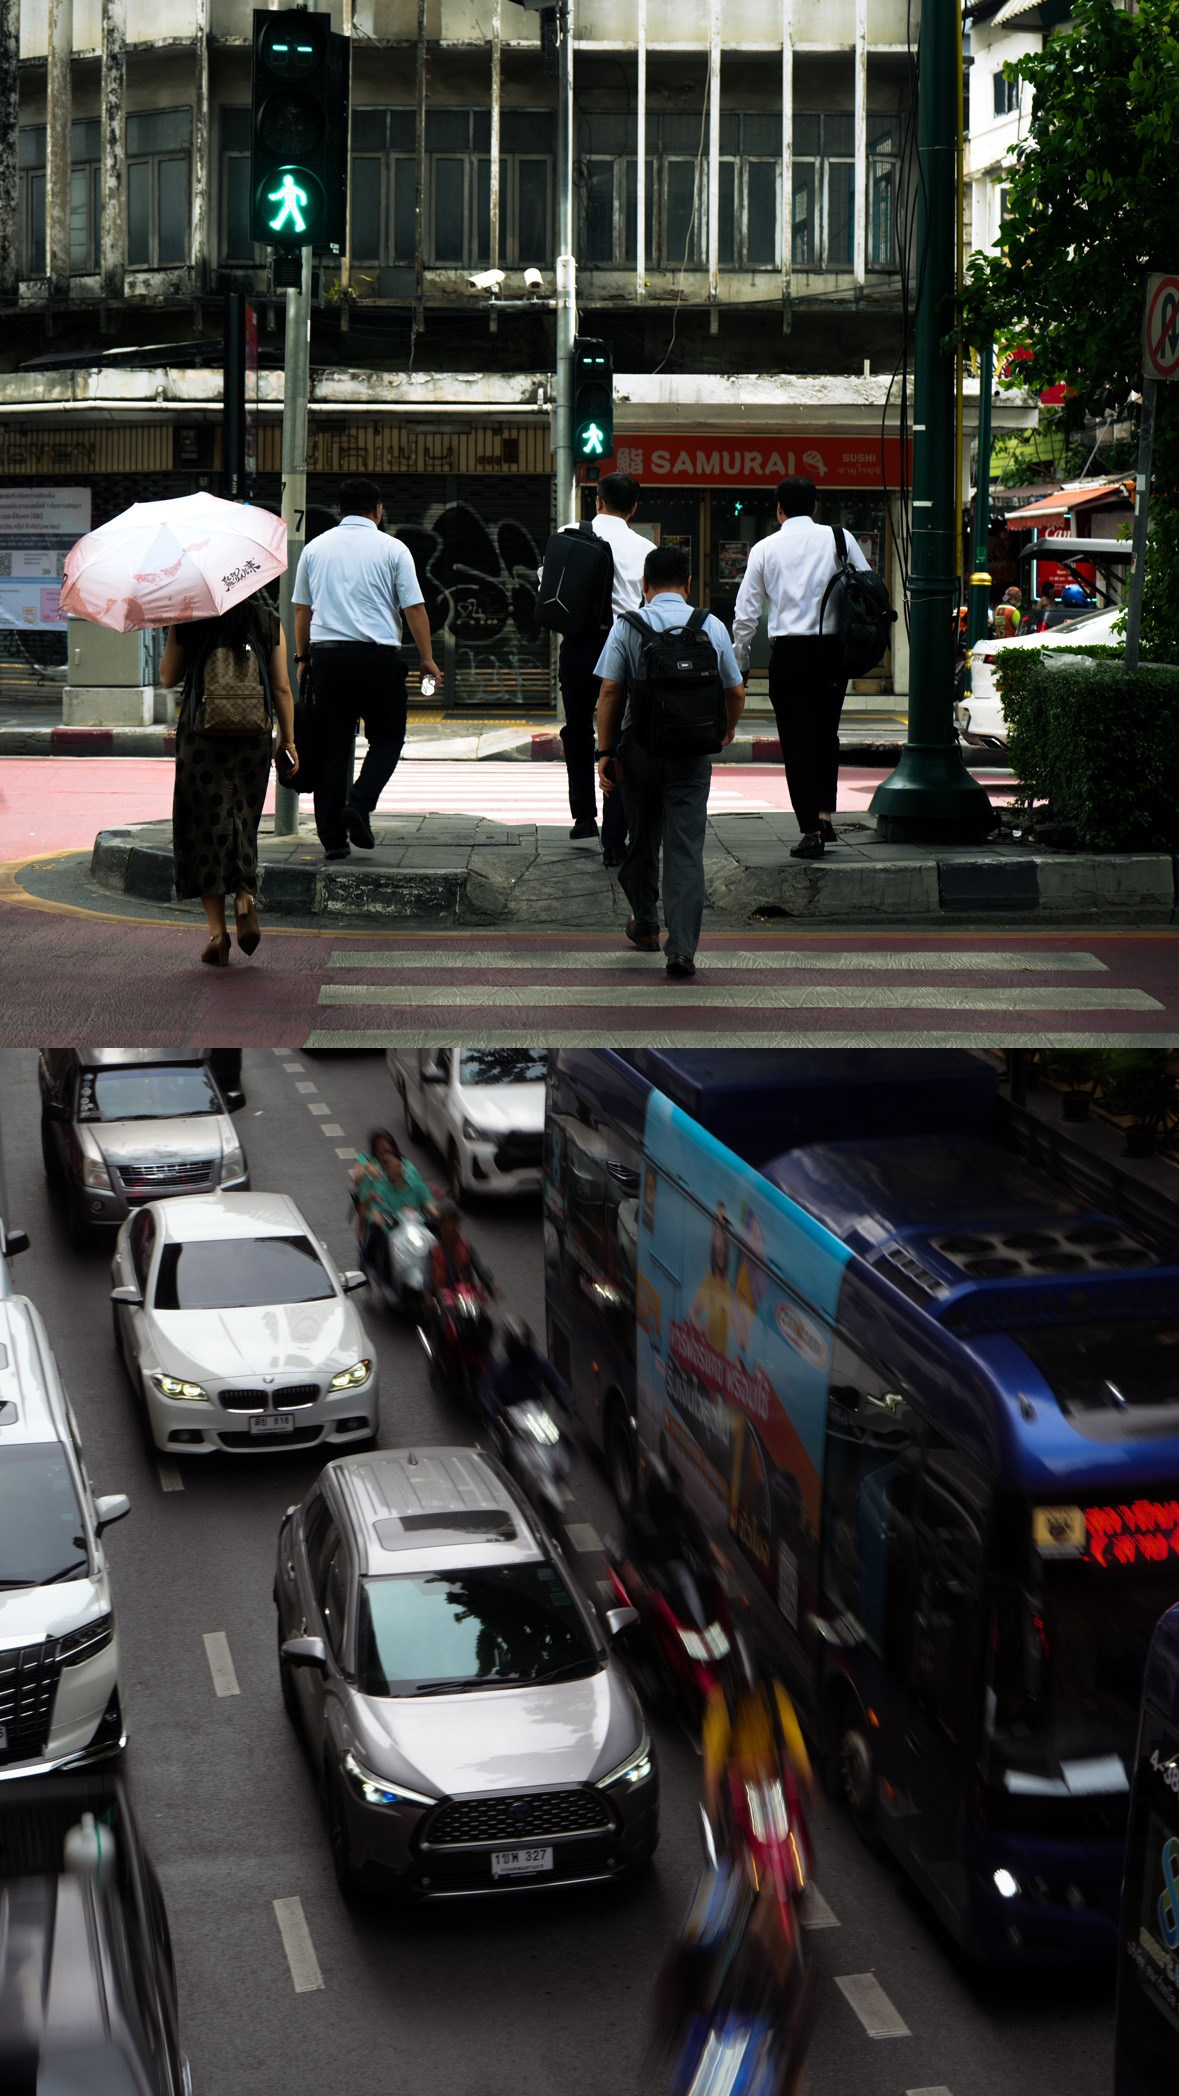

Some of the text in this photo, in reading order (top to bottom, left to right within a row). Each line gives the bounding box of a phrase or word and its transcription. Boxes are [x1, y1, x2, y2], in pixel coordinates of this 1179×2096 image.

[651, 450, 796, 475] SAMURAI
[842, 453, 877, 463] SUSHI
[293, 509, 305, 533] 7
[525, 1849, 547, 1862] 327
